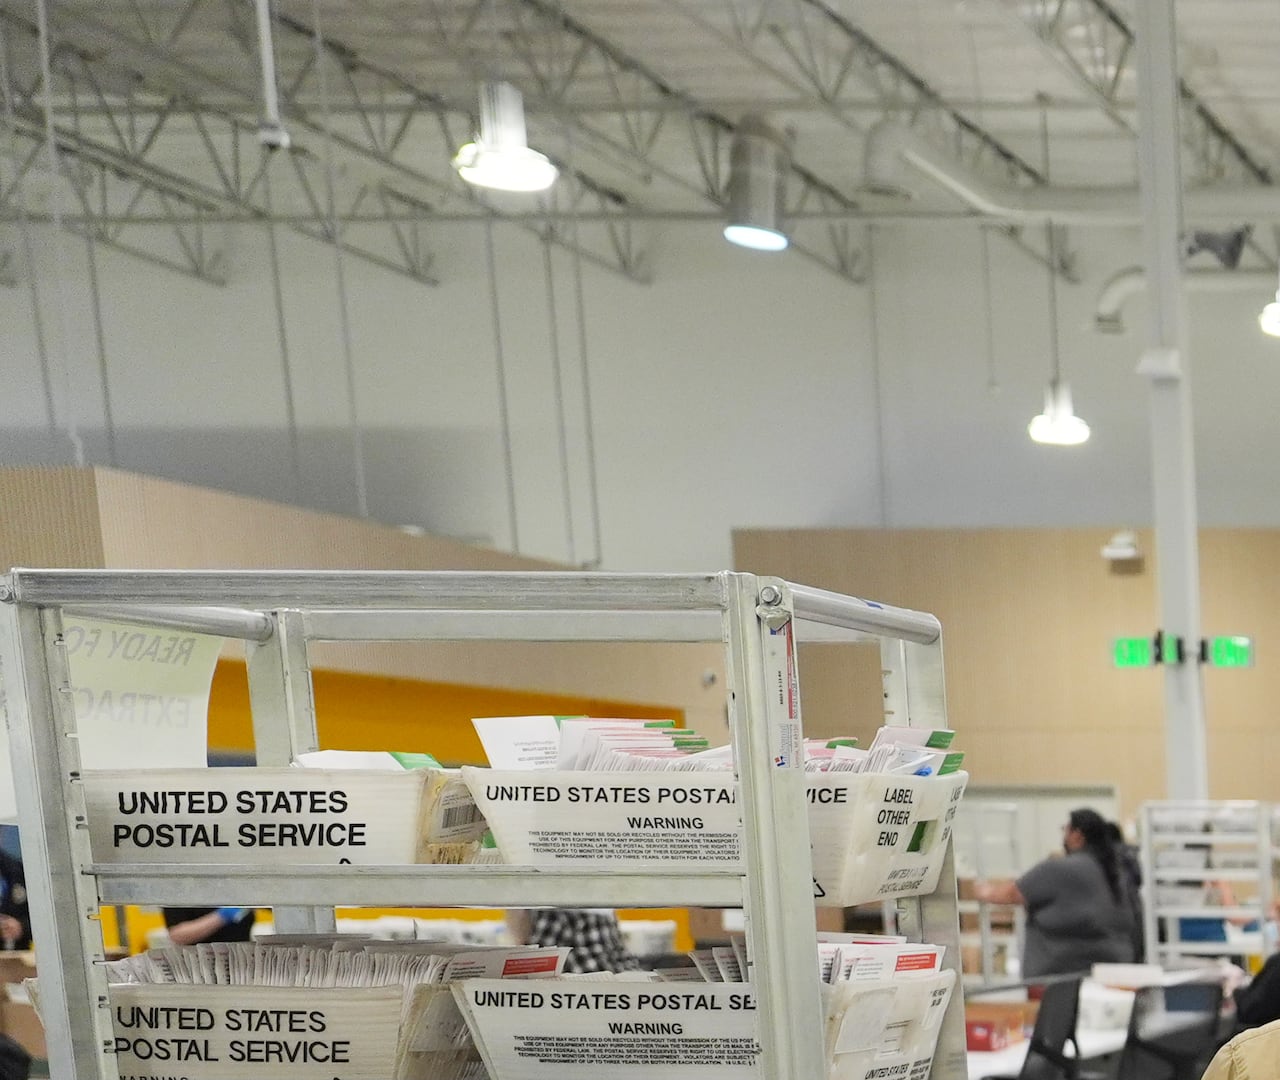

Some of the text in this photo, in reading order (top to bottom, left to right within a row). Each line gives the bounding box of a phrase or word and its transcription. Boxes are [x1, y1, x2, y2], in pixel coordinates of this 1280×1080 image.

[119, 791, 347, 814] UNITED STATES
[487, 786, 735, 803] UNITED STATES POSTA
[884, 788, 912, 804] LABEL
[628, 818, 703, 828] WARNING
[878, 810, 910, 824] OTHER
[114, 824, 366, 847] POSTAL SERVICE
[878, 832, 898, 846] END
[475, 991, 543, 1008] UNITED
[551, 994, 630, 1009] STATES
[638, 995, 721, 1010] POSTAL
[118, 1006, 326, 1032] UNITED STATES
[608, 1023, 682, 1034] WARNING
[114, 1038, 350, 1062] POSTAL SERVICE
